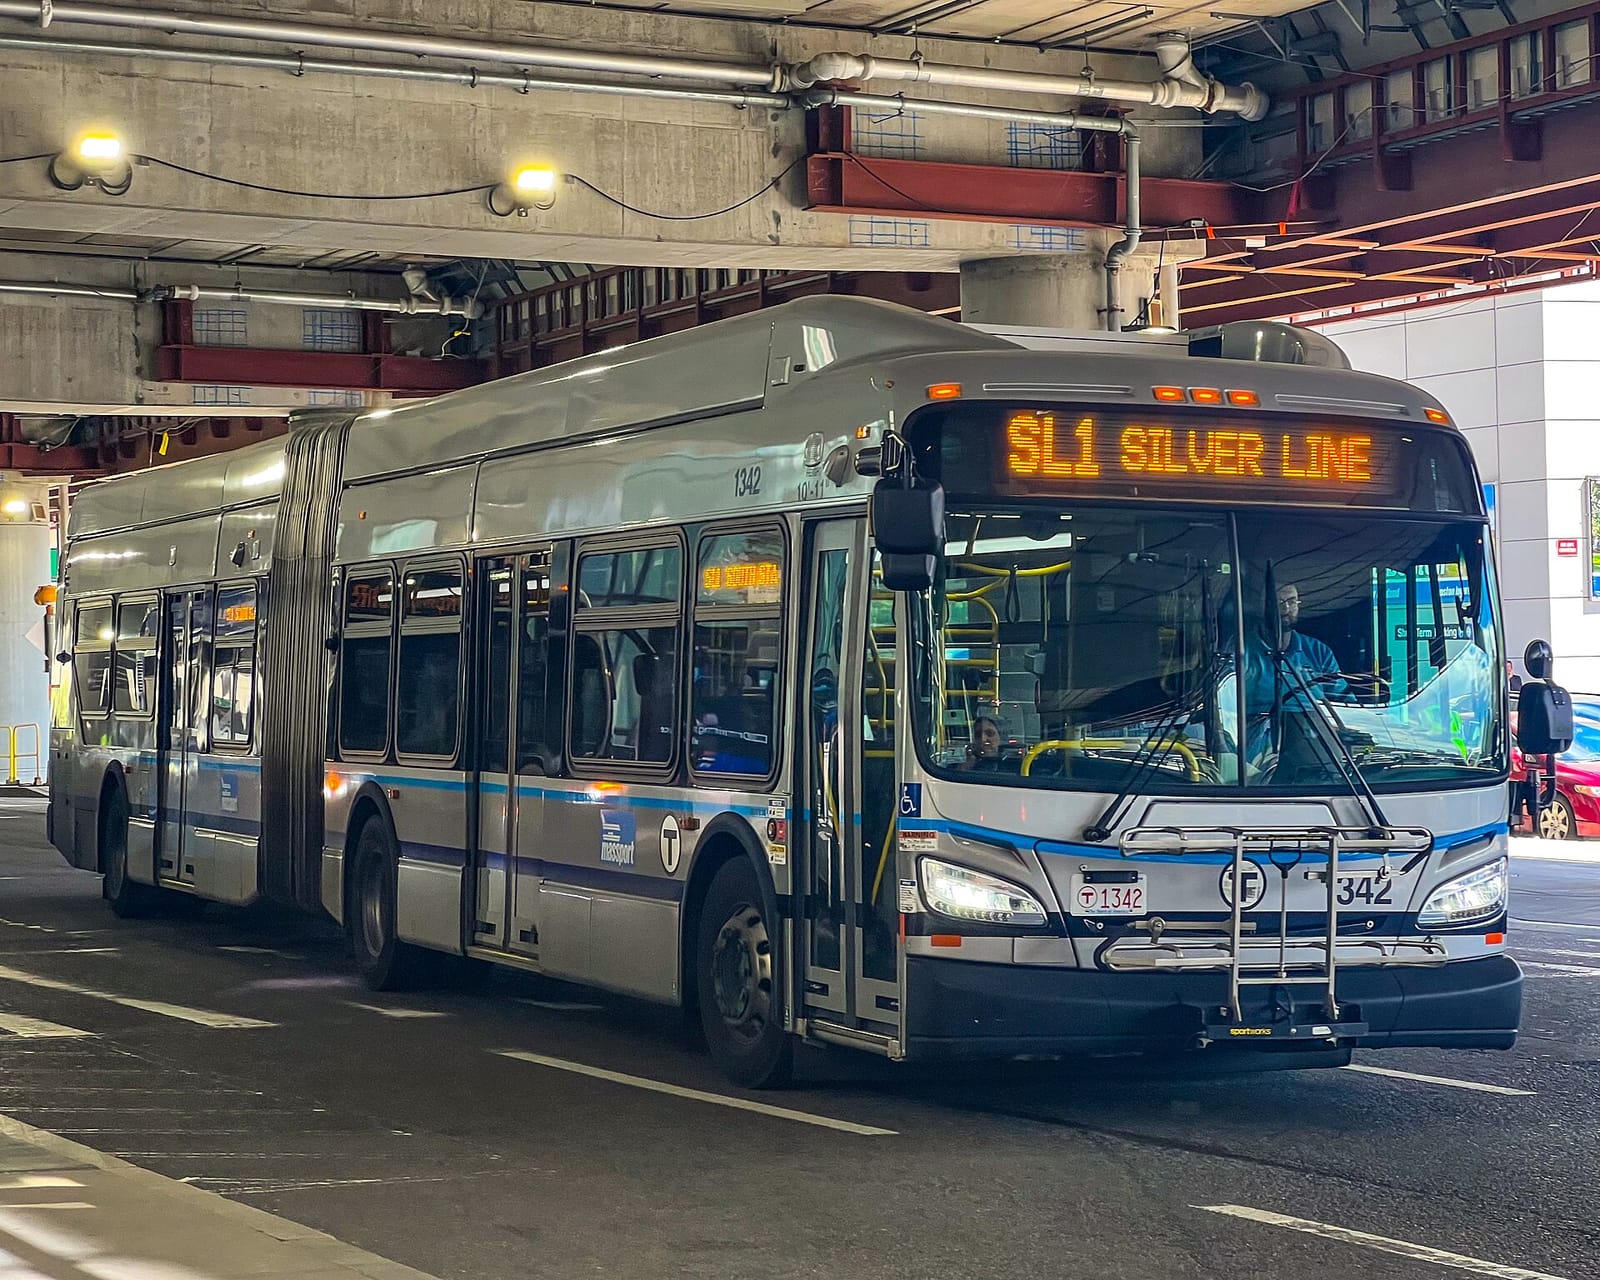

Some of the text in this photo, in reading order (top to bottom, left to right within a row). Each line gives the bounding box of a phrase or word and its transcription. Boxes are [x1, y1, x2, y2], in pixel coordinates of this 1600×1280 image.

[1008, 415, 1372, 481] SL1 SILVER LINE
[735, 466, 761, 497] 1342
[601, 841, 634, 866] massport
[1101, 887, 1143, 909] 1342
